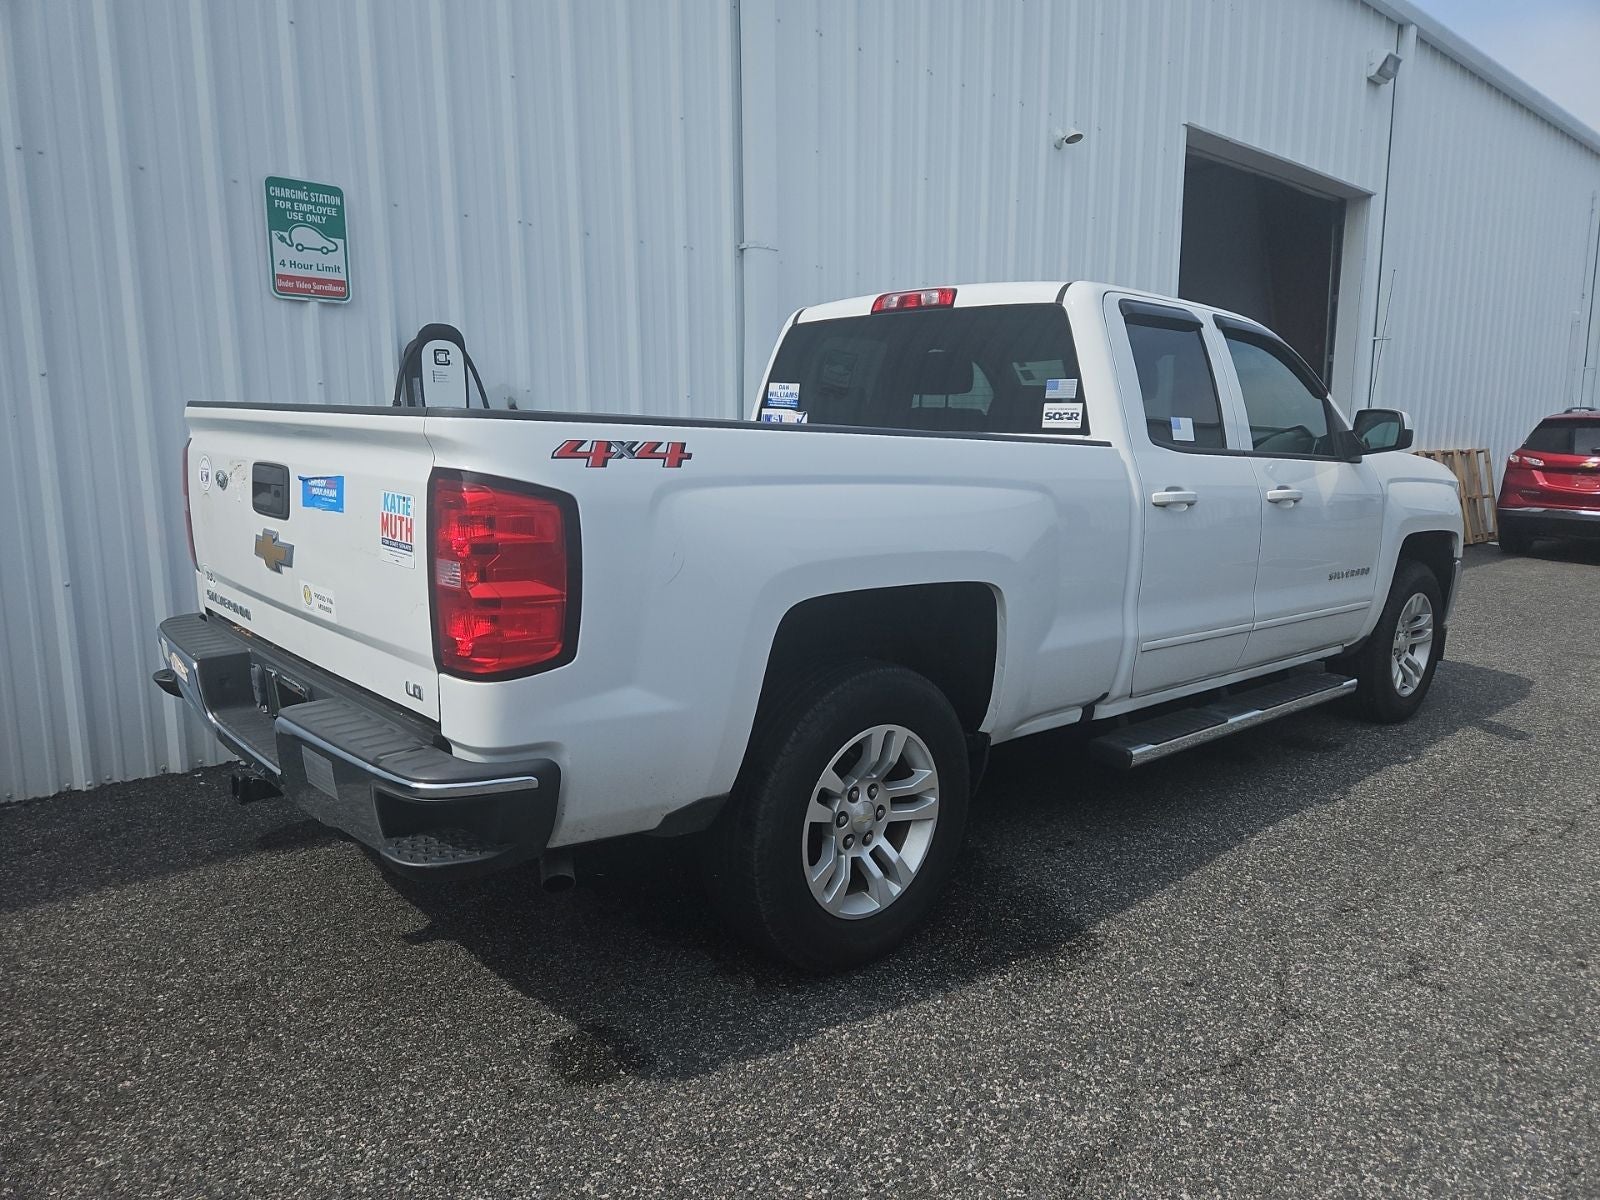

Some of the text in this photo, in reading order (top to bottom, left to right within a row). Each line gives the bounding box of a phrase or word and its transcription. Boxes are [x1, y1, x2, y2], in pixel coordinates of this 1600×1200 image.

[269, 186, 341, 206] CHARGING STATION
[274, 200, 338, 216] FOR EMPLOYEE
[286, 211, 327, 224] USE ONLY
[279, 259, 342, 273] 4 Hour Limit
[277, 278, 345, 293] Under Video Surveillance
[769, 391, 799, 399] WILLIAMS
[381, 511, 413, 543] MUTH
[1328, 567, 1370, 581] SILVERADO
[206, 588, 252, 621] SILVERADO
